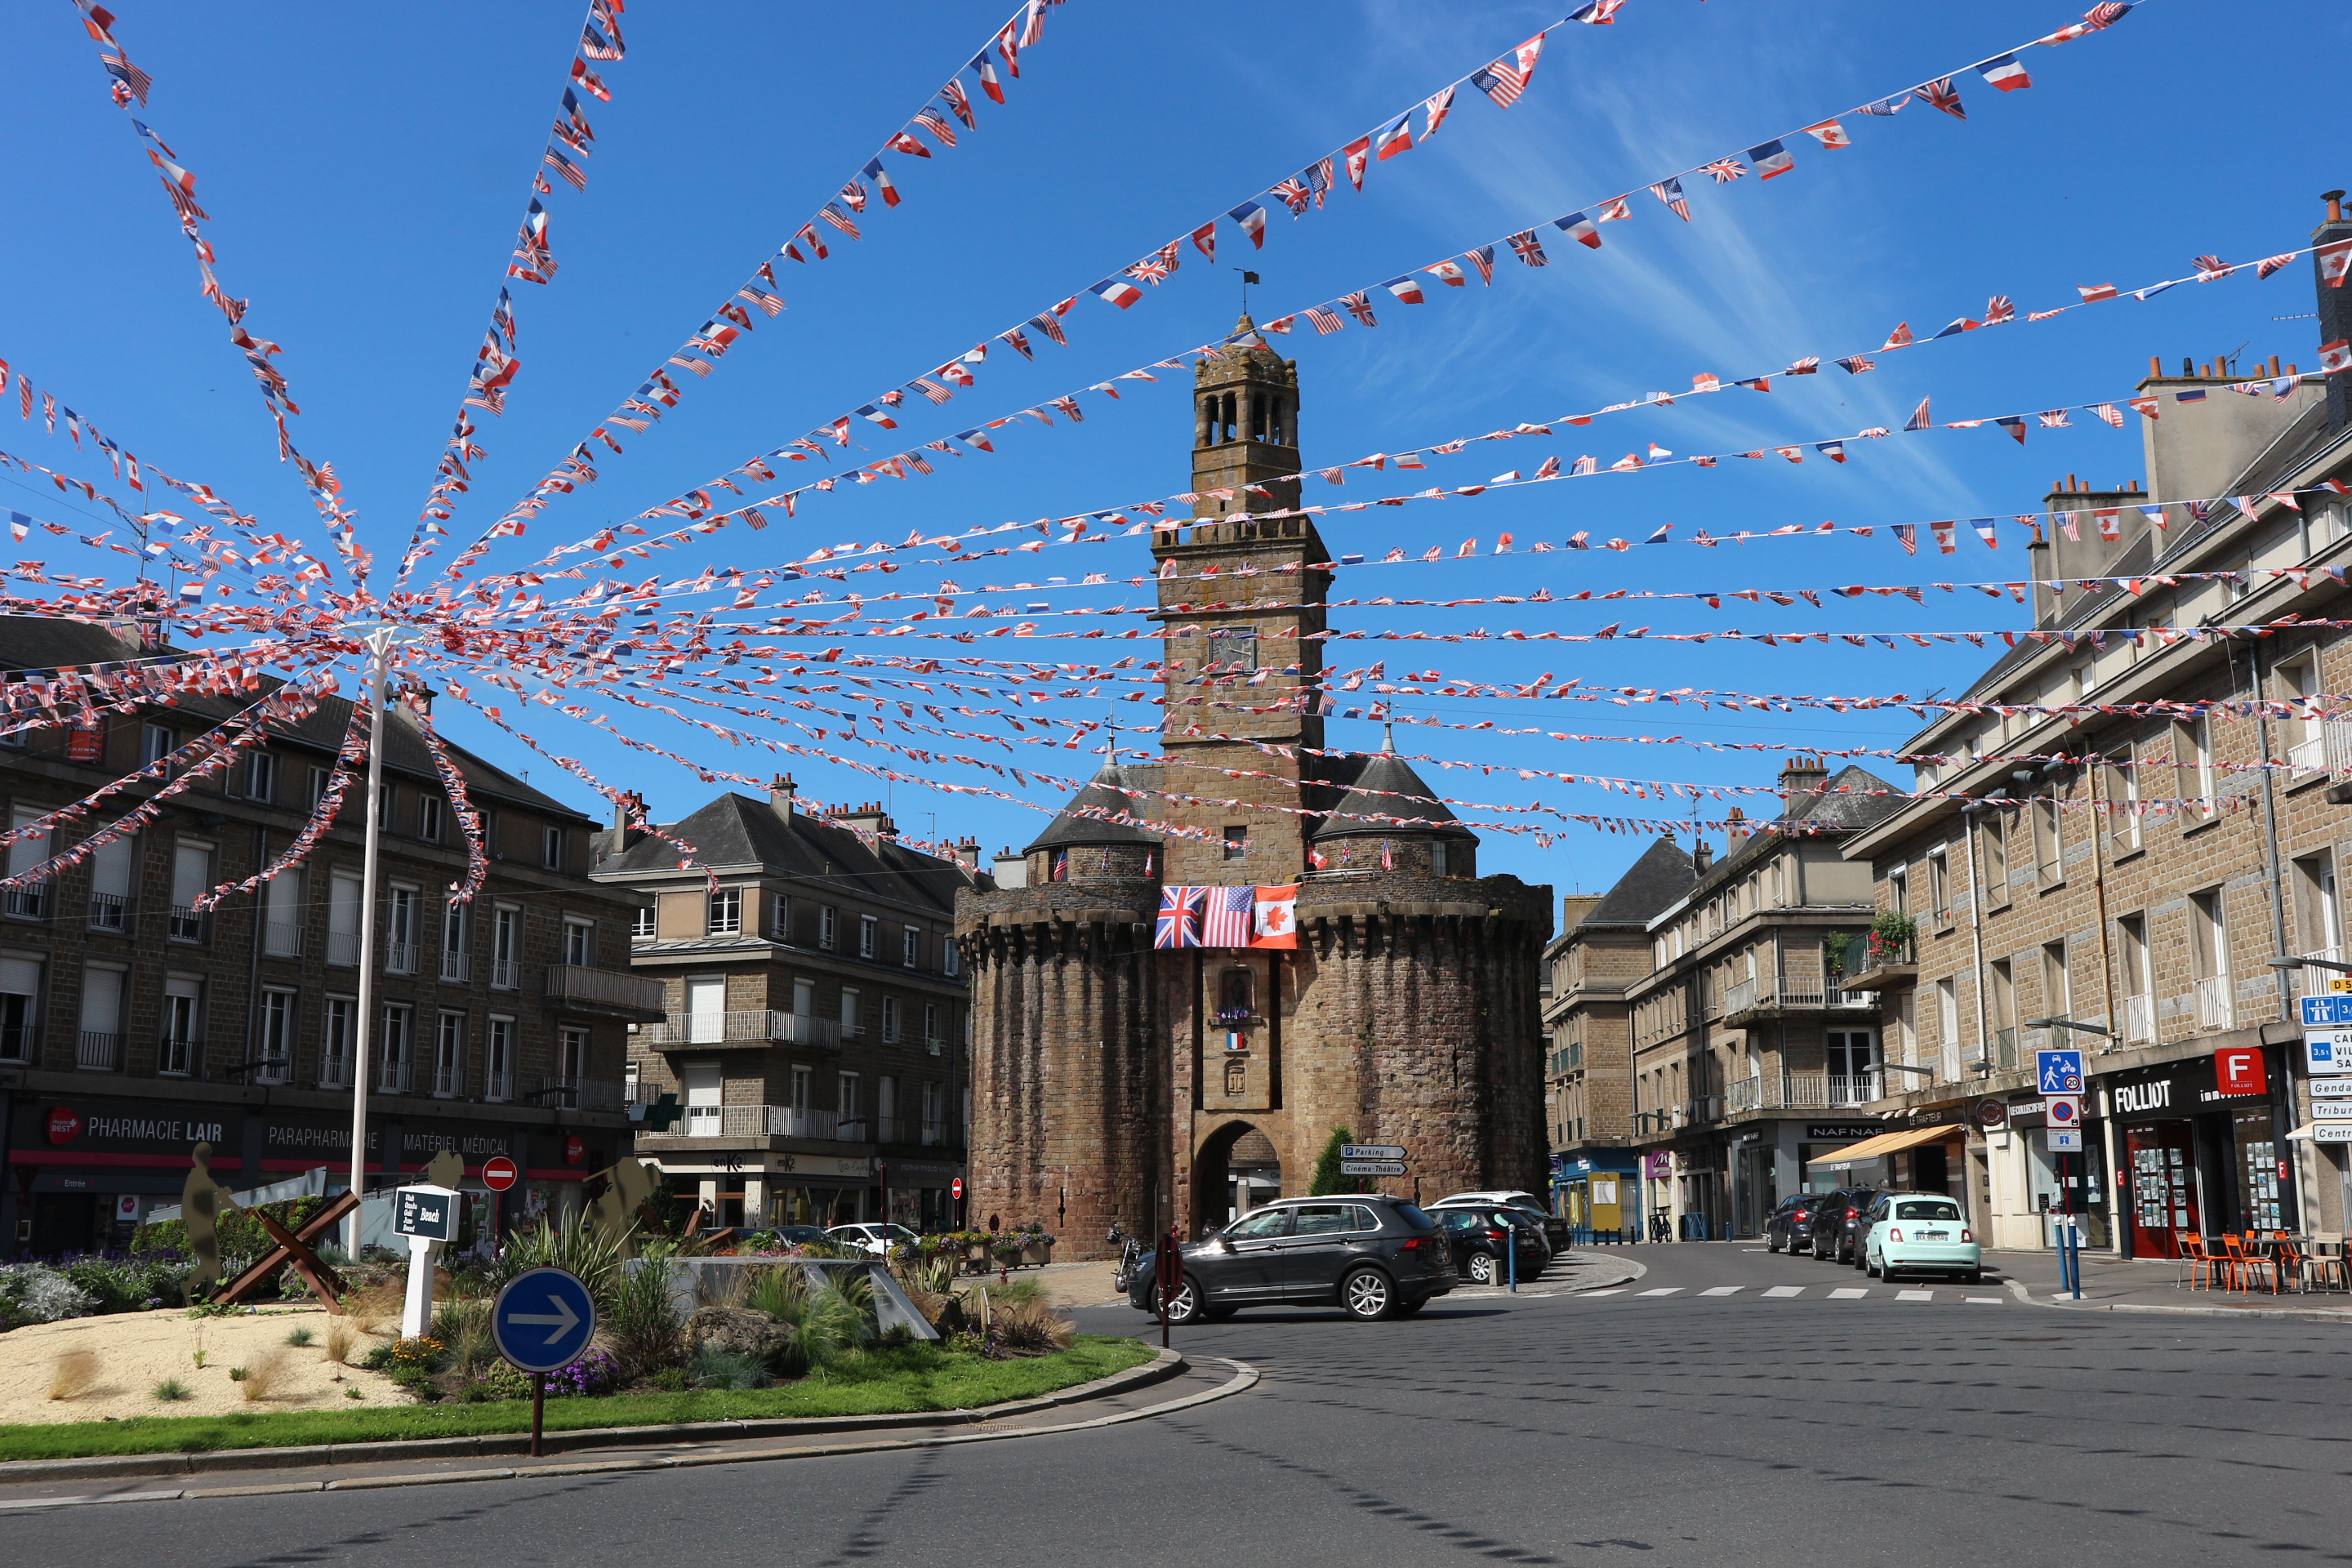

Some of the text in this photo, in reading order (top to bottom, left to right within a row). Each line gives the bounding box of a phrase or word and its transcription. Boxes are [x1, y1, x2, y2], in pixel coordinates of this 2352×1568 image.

[2335, 981, 2341, 989] D
[2229, 1055, 2251, 1081] F
[2115, 1080, 2171, 1113] FOLLIOT
[1909, 1112, 1942, 1125] LE TRAFTEUR
[88, 1117, 222, 1142] PHARMACIE LAIR
[270, 1127, 377, 1149] PARAPHARMIE
[404, 1132, 509, 1155] MATÉRIEL MÉDICAL
[1356, 1148, 1384, 1156] Parking
[2278, 1161, 2283, 1174] F
[65, 1179, 86, 1187] Entrée
[420, 1207, 439, 1223] Beach
